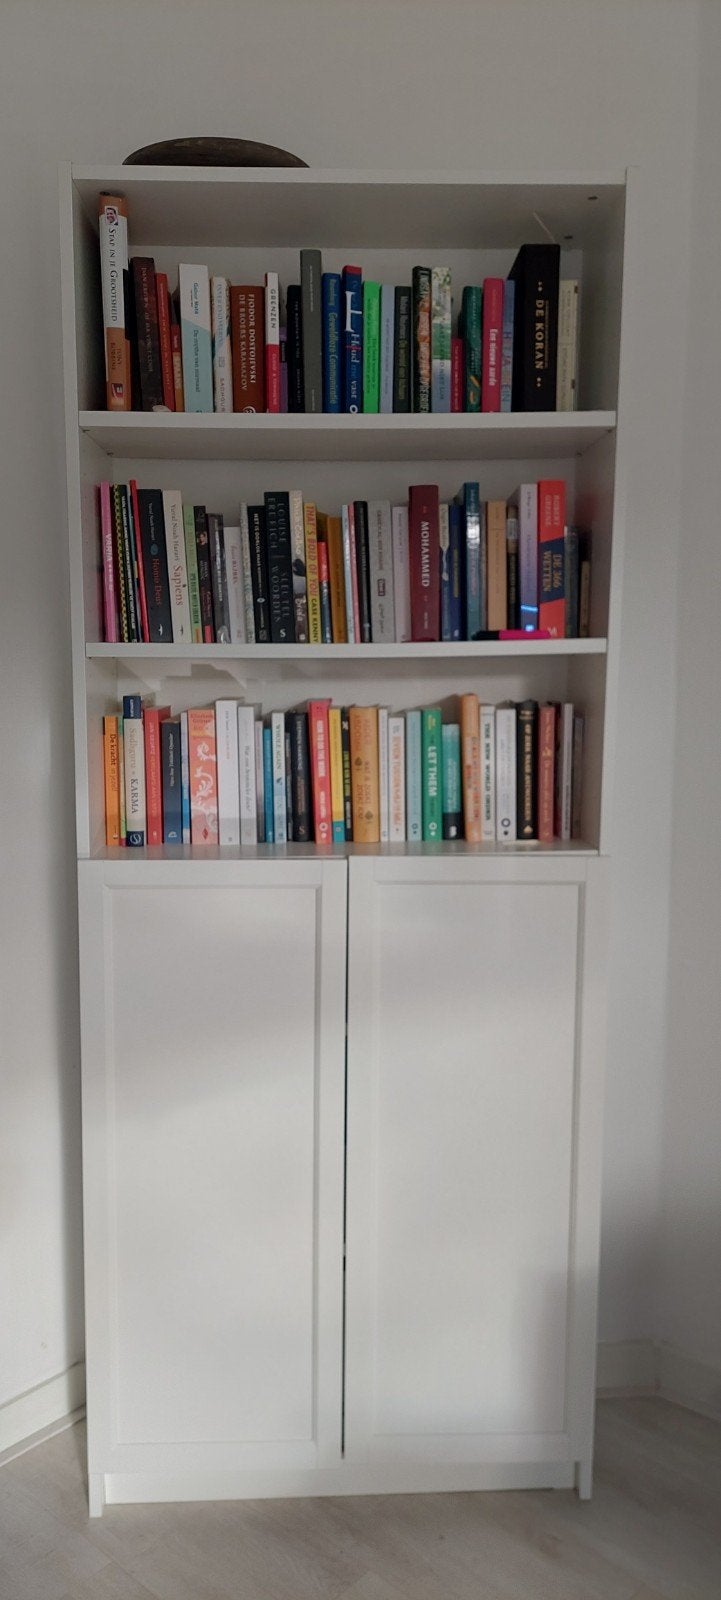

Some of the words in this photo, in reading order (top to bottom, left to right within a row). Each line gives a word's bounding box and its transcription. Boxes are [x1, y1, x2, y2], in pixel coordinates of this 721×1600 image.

[238, 294, 246, 304] DE
[248, 294, 256, 327] FJODOR
[536, 300, 544, 316] DE
[489, 328, 498, 340] Een
[535, 322, 544, 369] KORAN
[249, 328, 257, 384] DOSTOJEVSKI
[350, 333, 360, 362] Houd
[490, 342, 498, 366] nieuwe
[240, 341, 248, 390] KARAMAZOV
[489, 367, 497, 386] aarde
[330, 354, 338, 404] Communicatie
[170, 504, 178, 522] Yuval
[278, 503, 287, 542] LOUISE
[306, 506, 316, 536] THAT'S
[308, 538, 317, 561] BOLD
[420, 521, 430, 587] MOHAMMED
[553, 554, 562, 568] DE
[152, 558, 160, 584] Homo
[308, 564, 317, 576] OF
[542, 550, 552, 592] WETTEN
[553, 570, 562, 588] 366
[154, 586, 162, 606] Deus
[172, 564, 184, 606] Sapiens
[309, 578, 318, 596] YOU
[110, 734, 116, 744] De
[129, 728, 139, 768] Sadhguru
[428, 746, 437, 766] LET
[428, 768, 437, 796] THEM
[130, 778, 139, 814] KARMA
